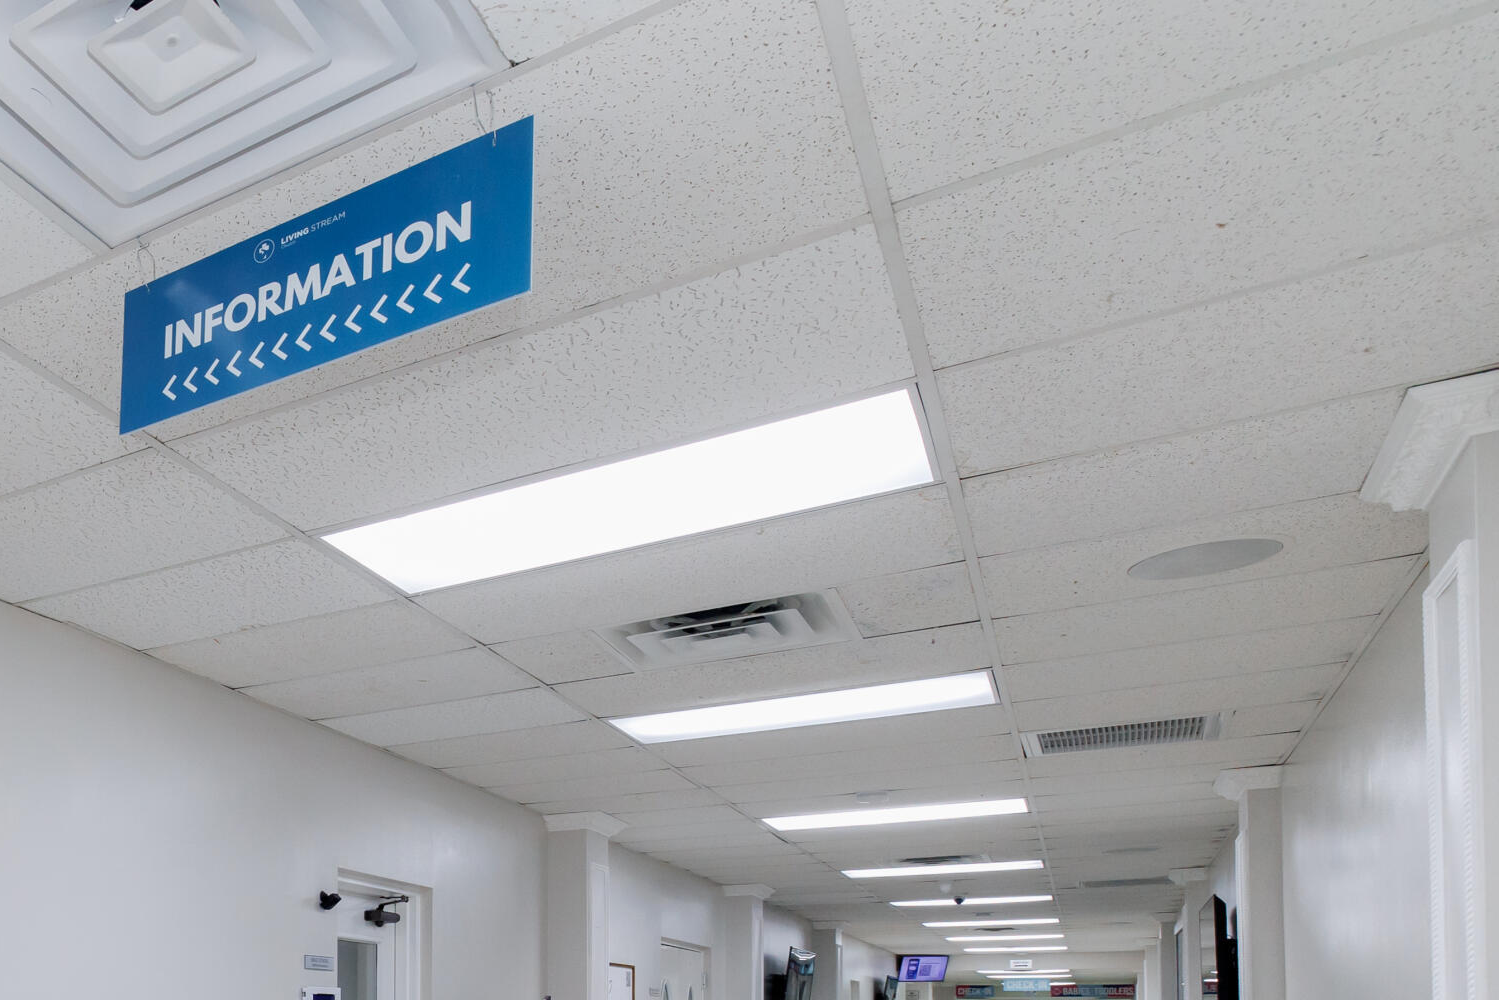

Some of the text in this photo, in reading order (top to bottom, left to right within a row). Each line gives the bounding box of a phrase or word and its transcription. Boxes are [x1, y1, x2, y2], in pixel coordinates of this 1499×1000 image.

[280, 227, 310, 245] LIVING
[310, 211, 346, 233] STREAM
[164, 200, 472, 360] INFORMATION
